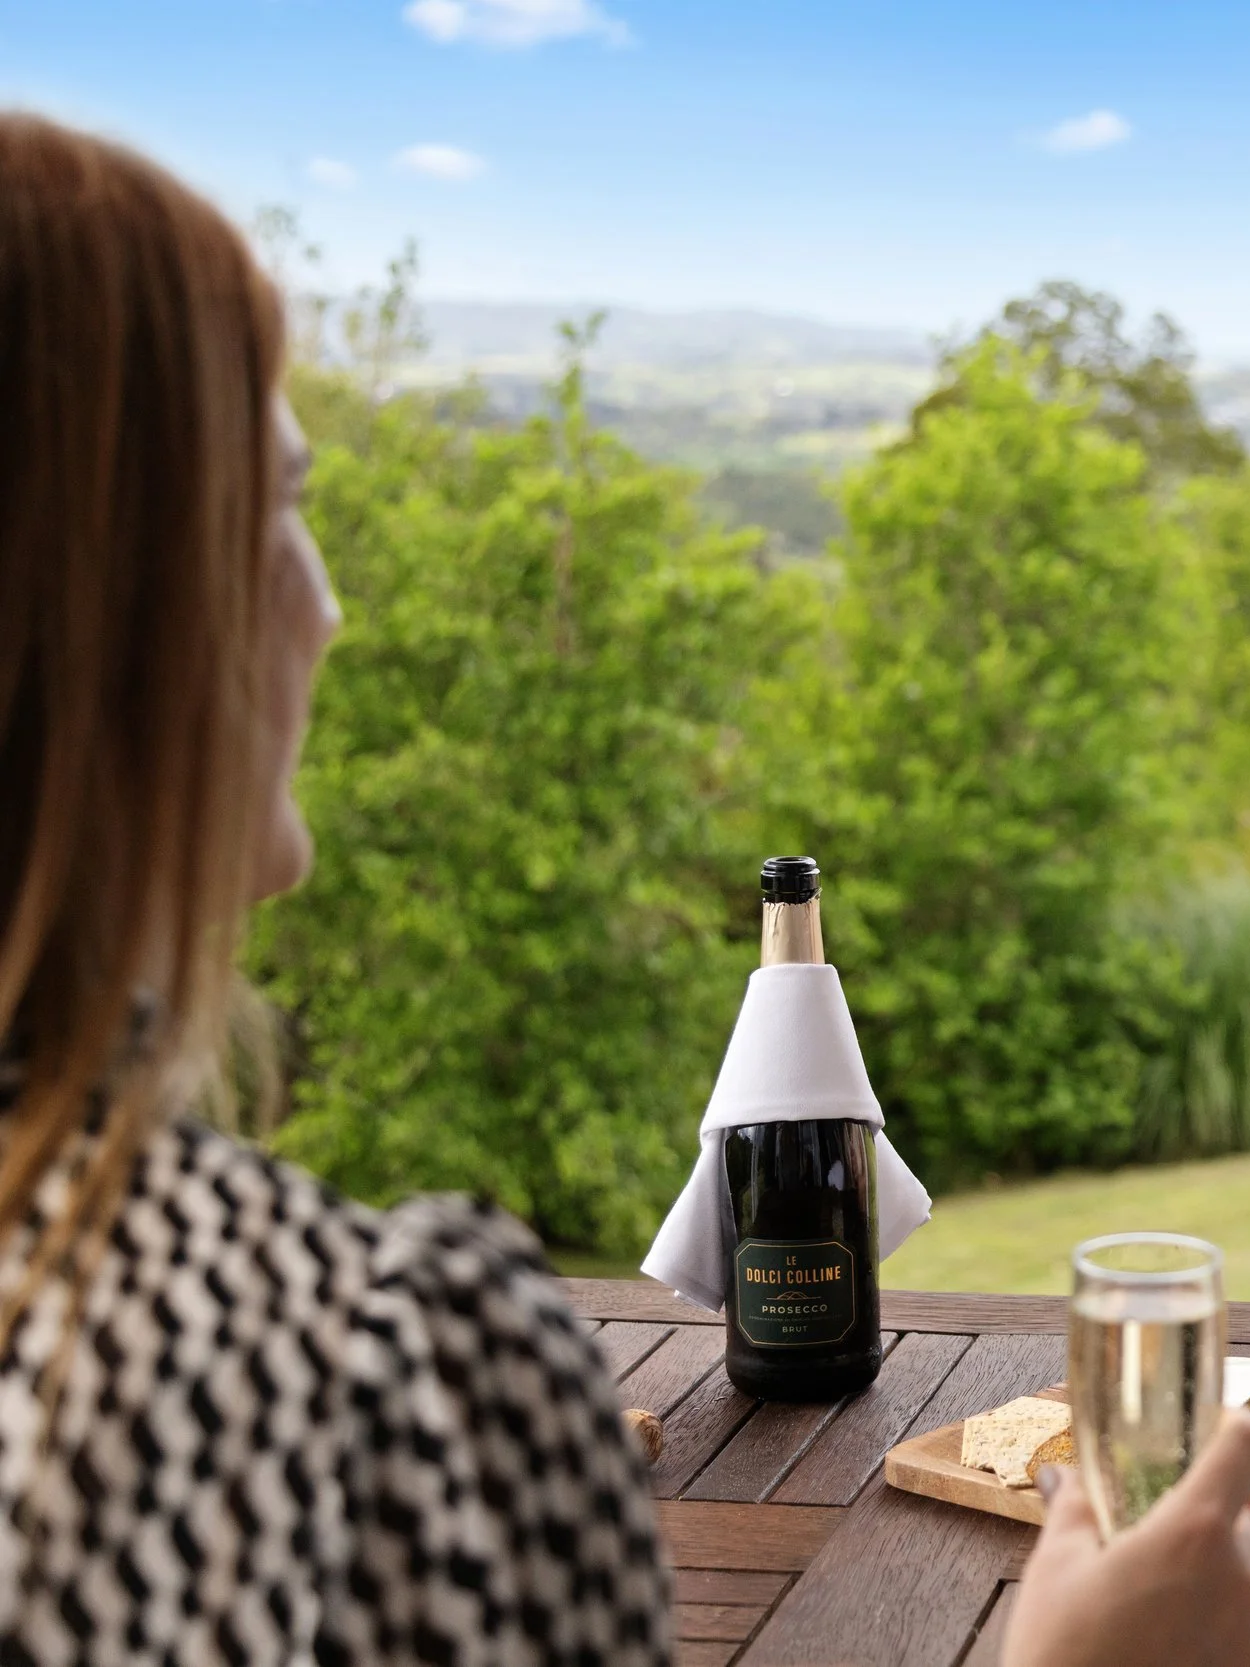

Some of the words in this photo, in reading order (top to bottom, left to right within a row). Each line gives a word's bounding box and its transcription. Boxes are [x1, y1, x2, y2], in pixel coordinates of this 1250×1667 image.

[786, 1255, 797, 1266] LE
[746, 1267, 781, 1284] DOLCI
[787, 1265, 841, 1284] COLLINE
[762, 1304, 828, 1314] PROSECCO
